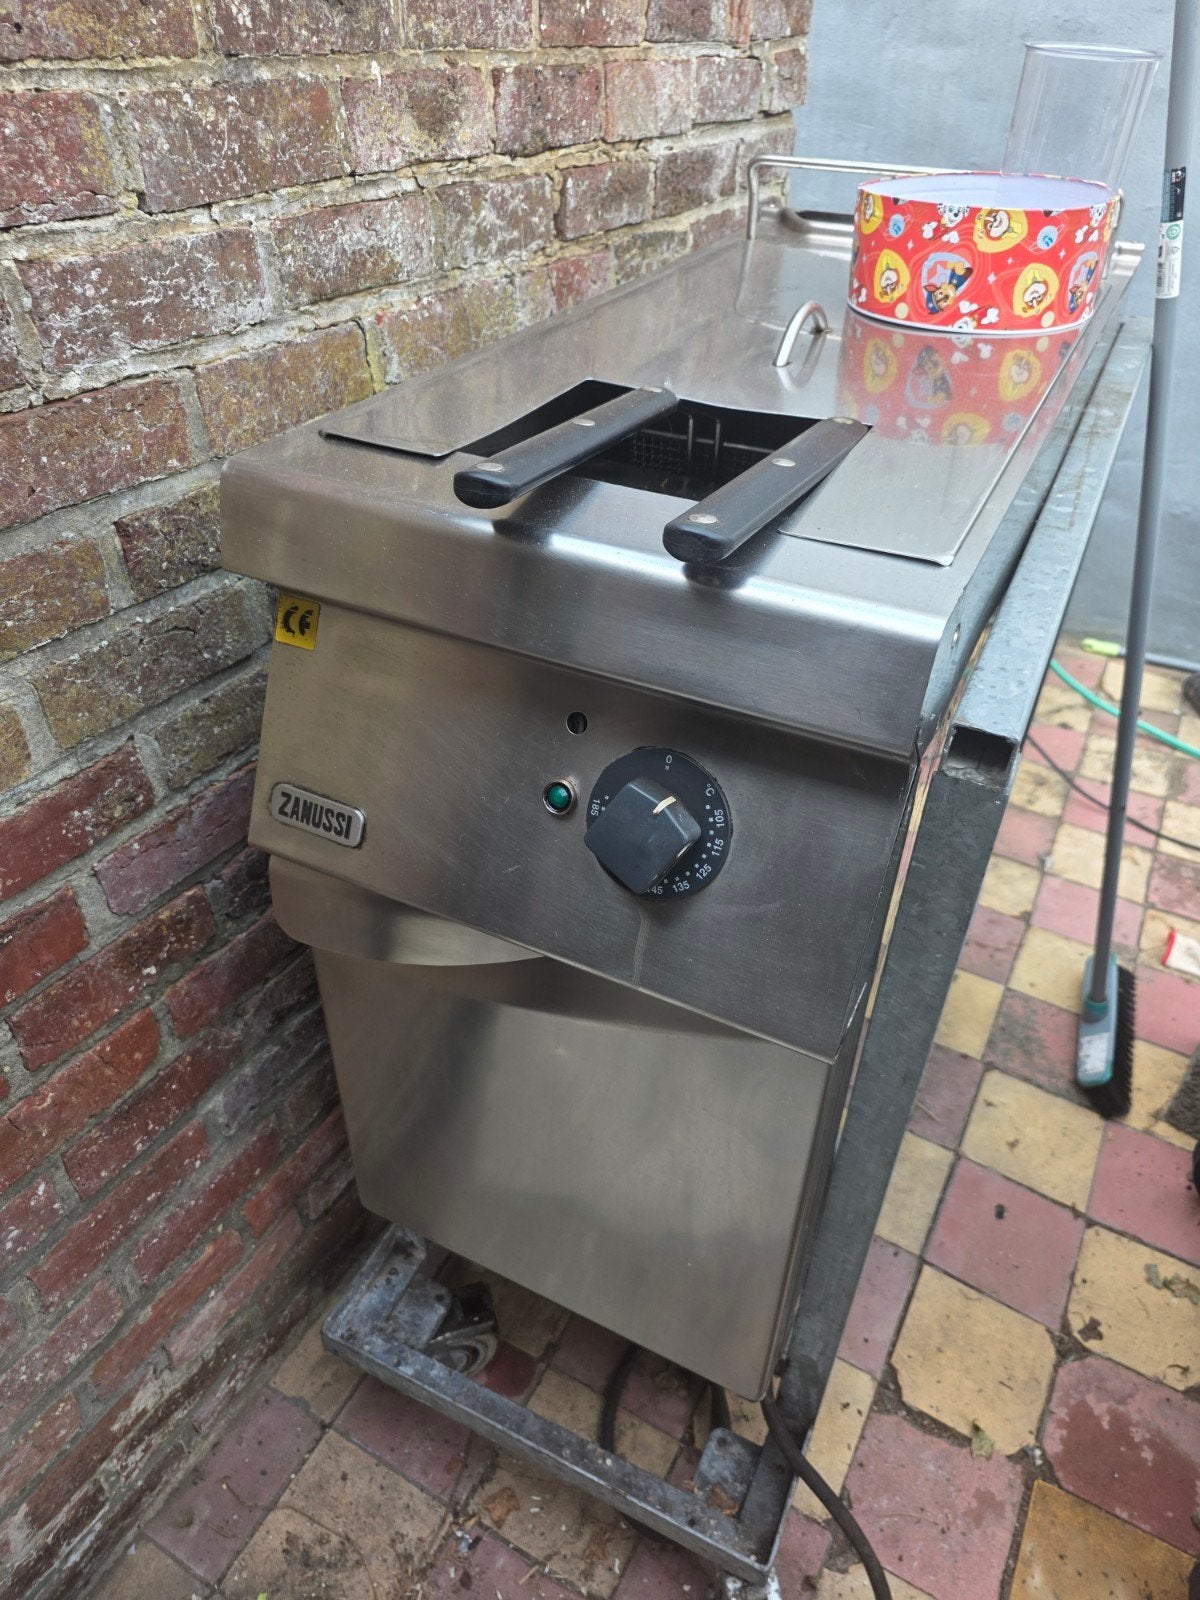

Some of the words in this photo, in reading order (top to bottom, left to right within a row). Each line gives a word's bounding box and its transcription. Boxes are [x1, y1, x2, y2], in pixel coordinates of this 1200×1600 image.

[278, 791, 353, 840] ZANUSSI
[590, 799, 601, 816] 185
[713, 809, 725, 828] 105
[711, 838, 724, 856] 115
[695, 863, 712, 880] 125
[672, 880, 690, 892] 135
